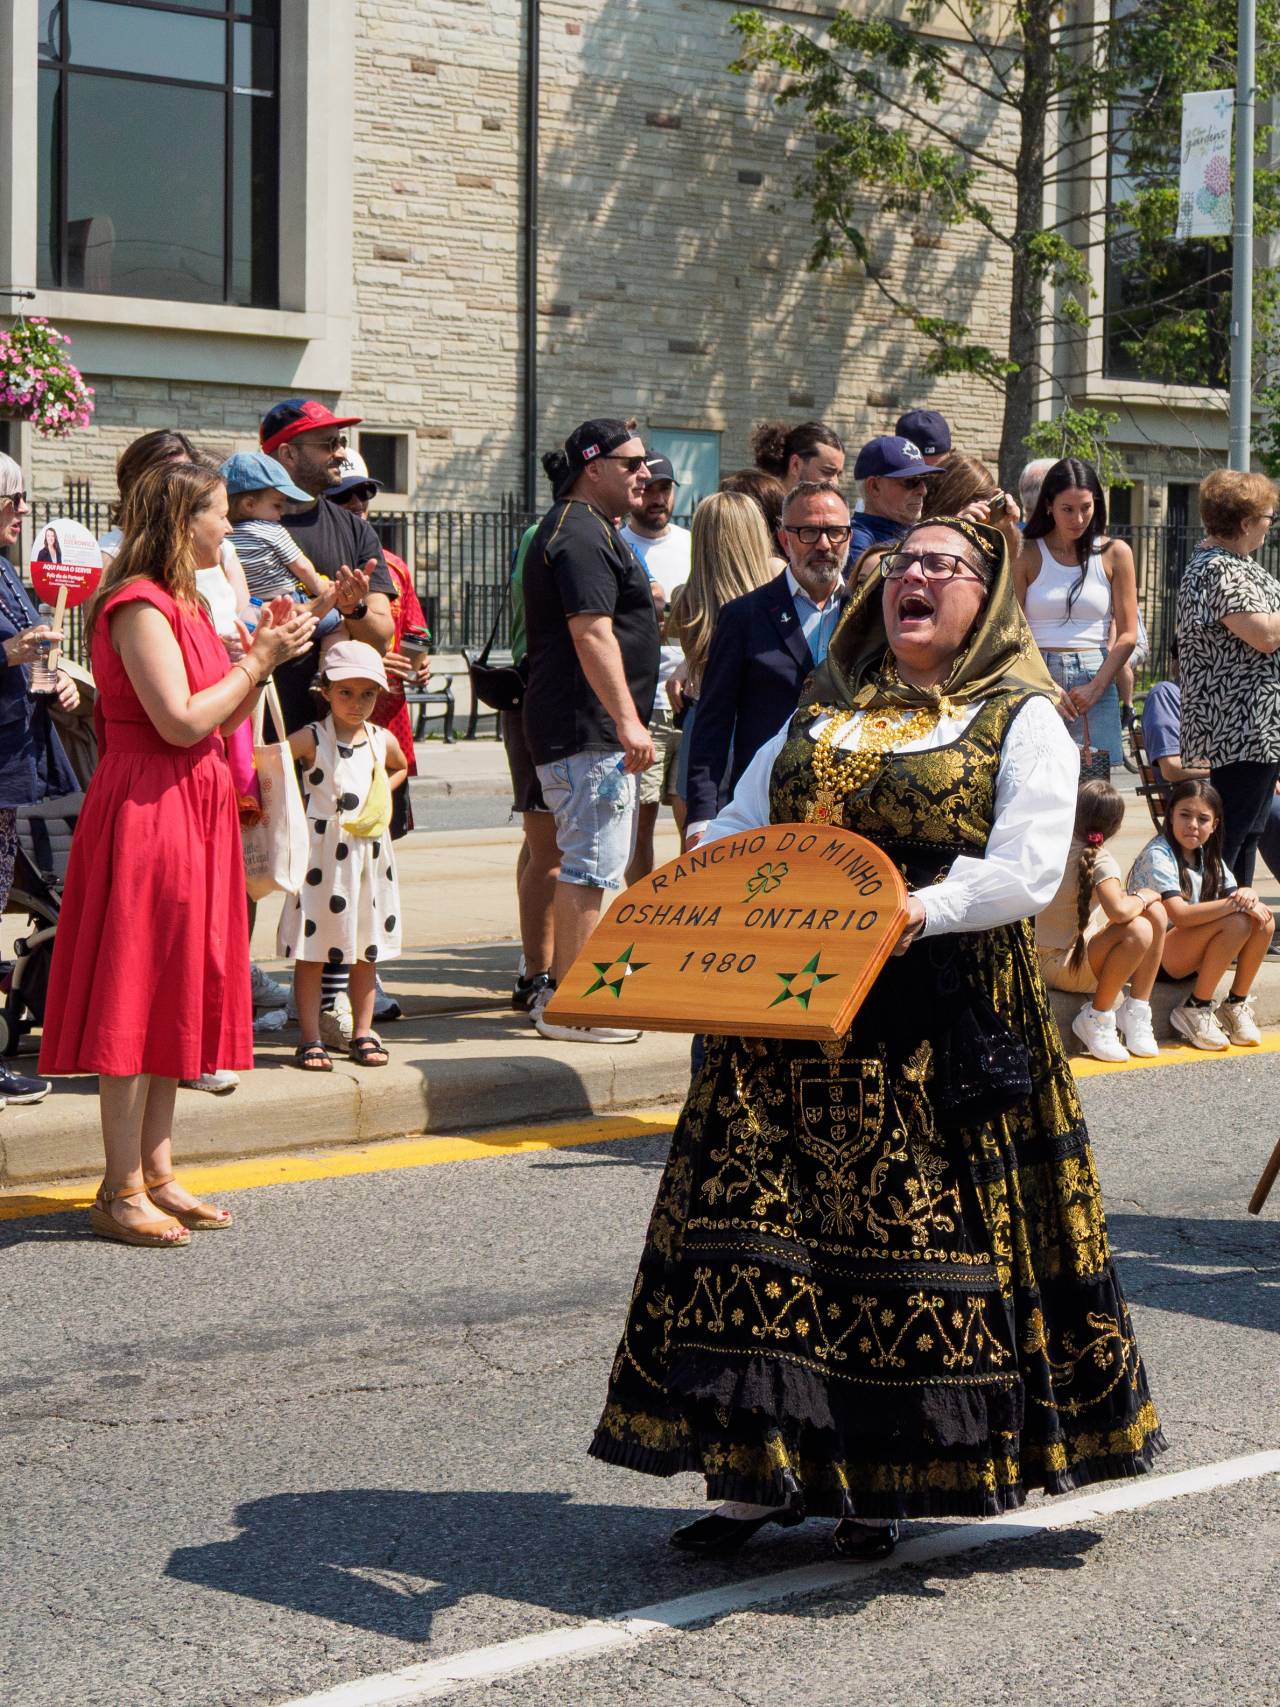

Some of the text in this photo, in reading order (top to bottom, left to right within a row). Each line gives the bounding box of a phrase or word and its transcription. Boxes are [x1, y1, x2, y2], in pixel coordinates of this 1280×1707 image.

[651, 833, 883, 896] RANCHO DO MINHO
[615, 904, 878, 931] OSHAWA ONTARIO
[679, 951, 757, 974] 1980
